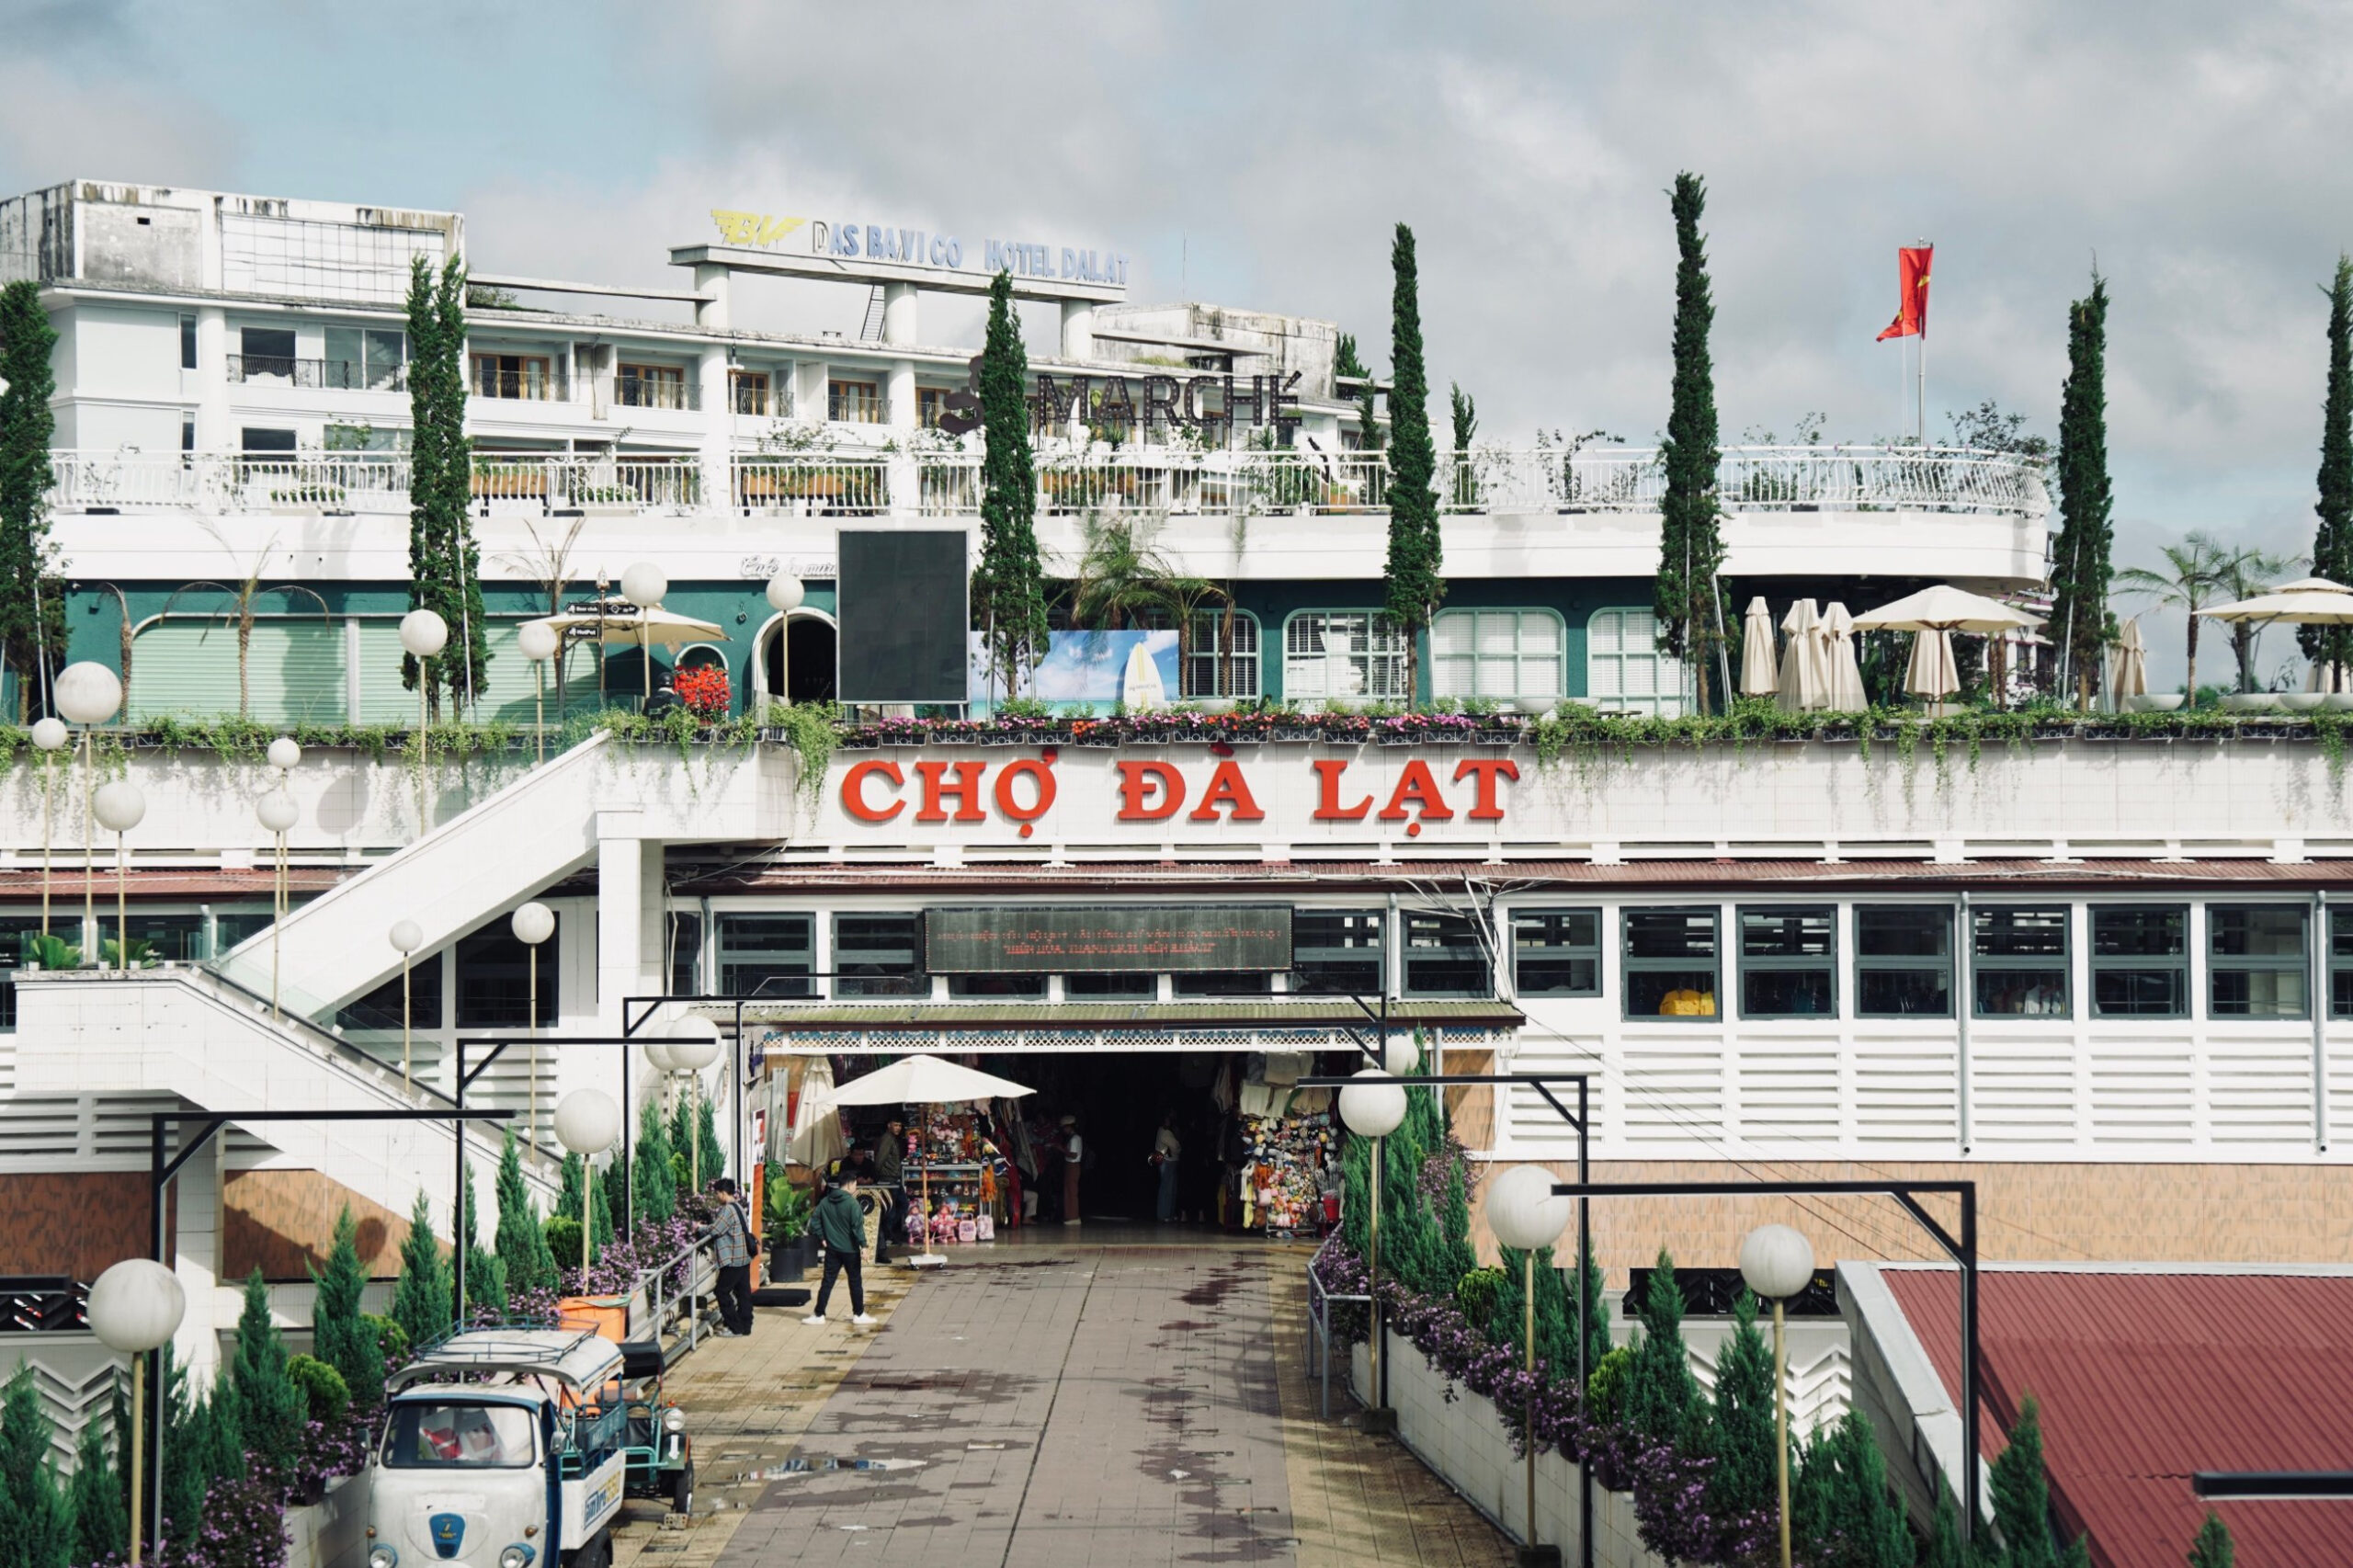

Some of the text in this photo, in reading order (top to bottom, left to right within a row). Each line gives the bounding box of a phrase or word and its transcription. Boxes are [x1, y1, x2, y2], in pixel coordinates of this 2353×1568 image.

[813, 220, 859, 256] DAS
[984, 239, 1056, 277] HOTEL
[1062, 246, 1129, 285] DALAT
[1037, 370, 1302, 426] MARCHÉ
[842, 741, 1520, 839] CHỢ ĐÀ LẠT
